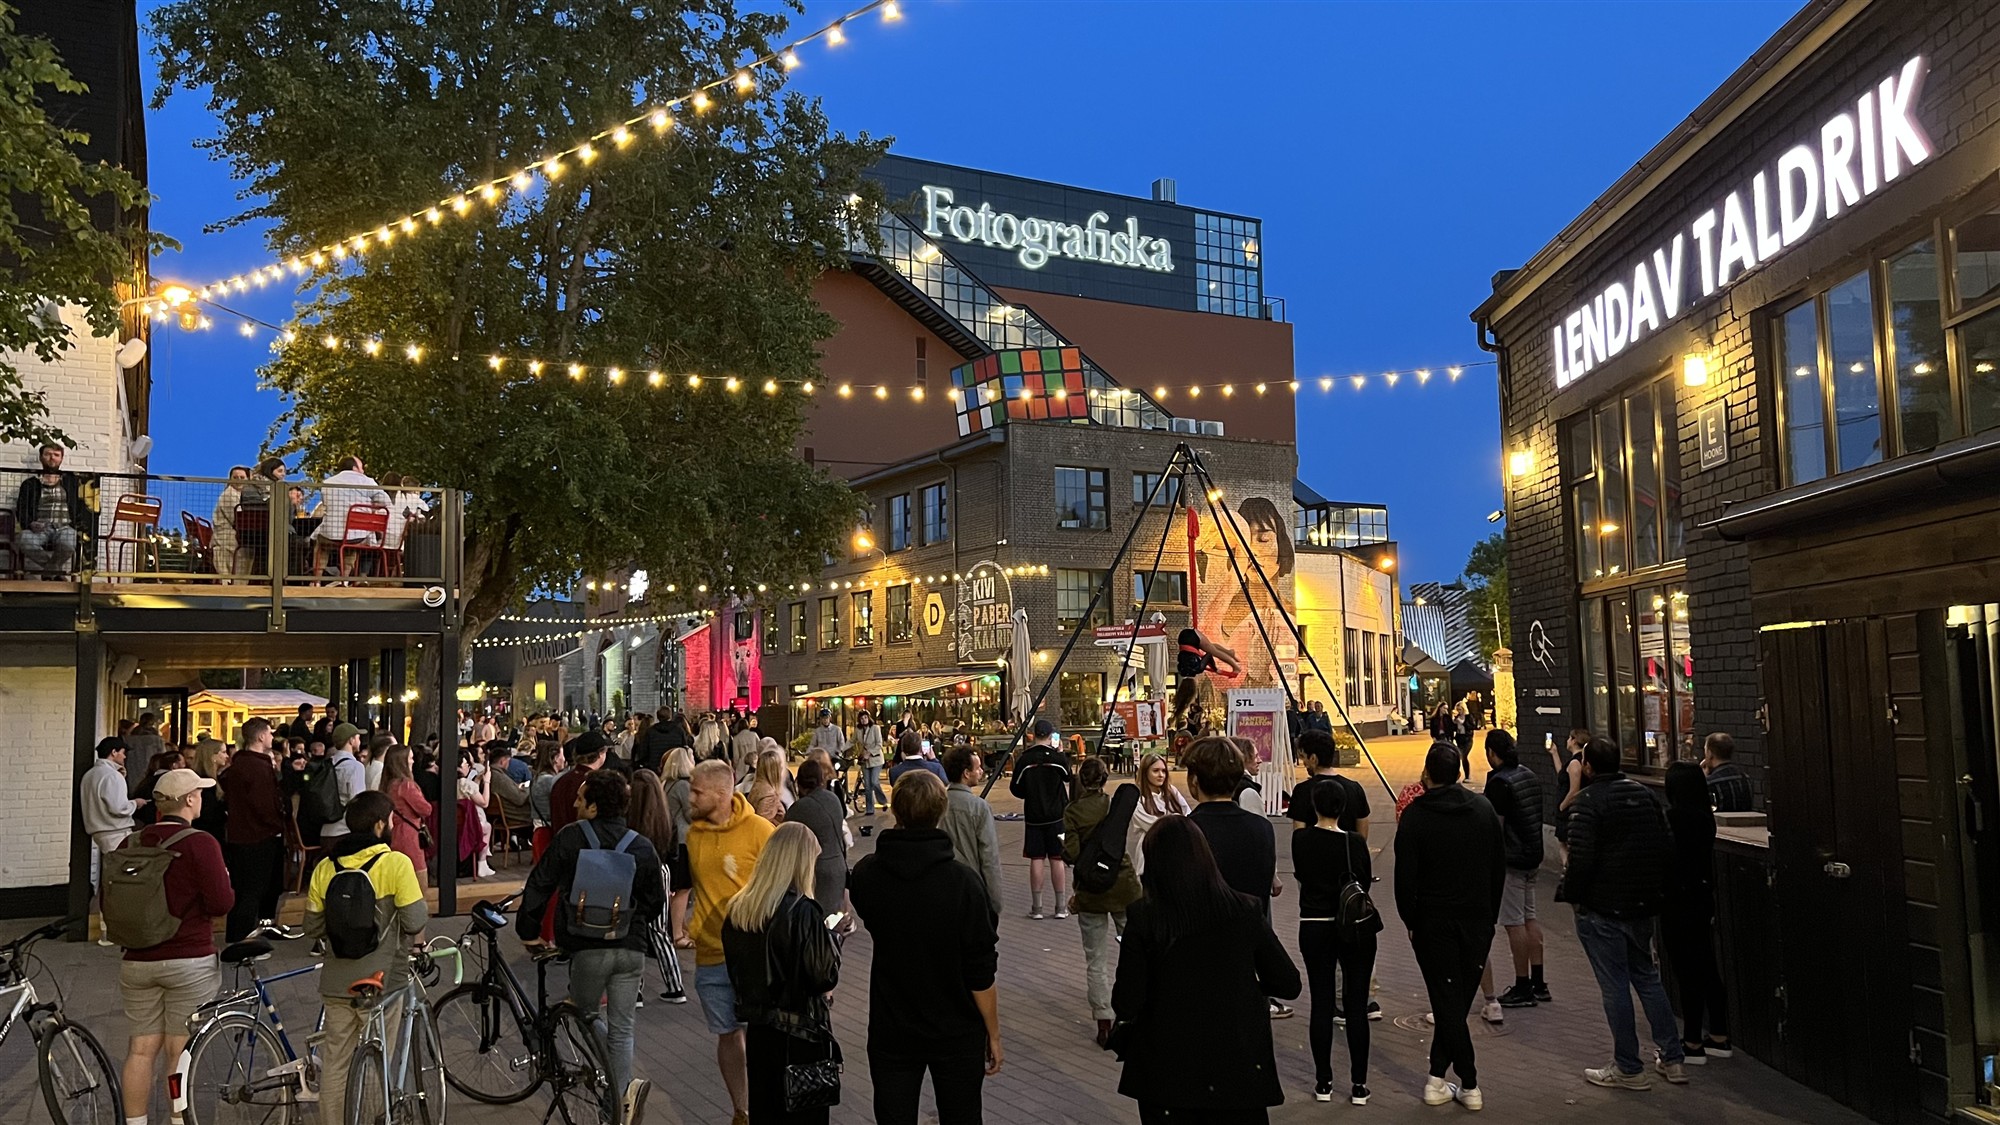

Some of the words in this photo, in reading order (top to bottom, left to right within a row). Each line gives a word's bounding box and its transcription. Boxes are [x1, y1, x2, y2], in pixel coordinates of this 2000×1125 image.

[922, 185, 1175, 269] Fotografiska
[1552, 232, 1684, 390] LENDAV
[1692, 55, 1931, 298] TALDRIK
[1707, 417, 1717, 445] E
[1704, 445, 1723, 461] HOONE
[973, 576, 995, 601] KIVI
[929, 602, 940, 627] D
[973, 602, 1011, 627] PABER
[1235, 699, 1254, 707] STL
